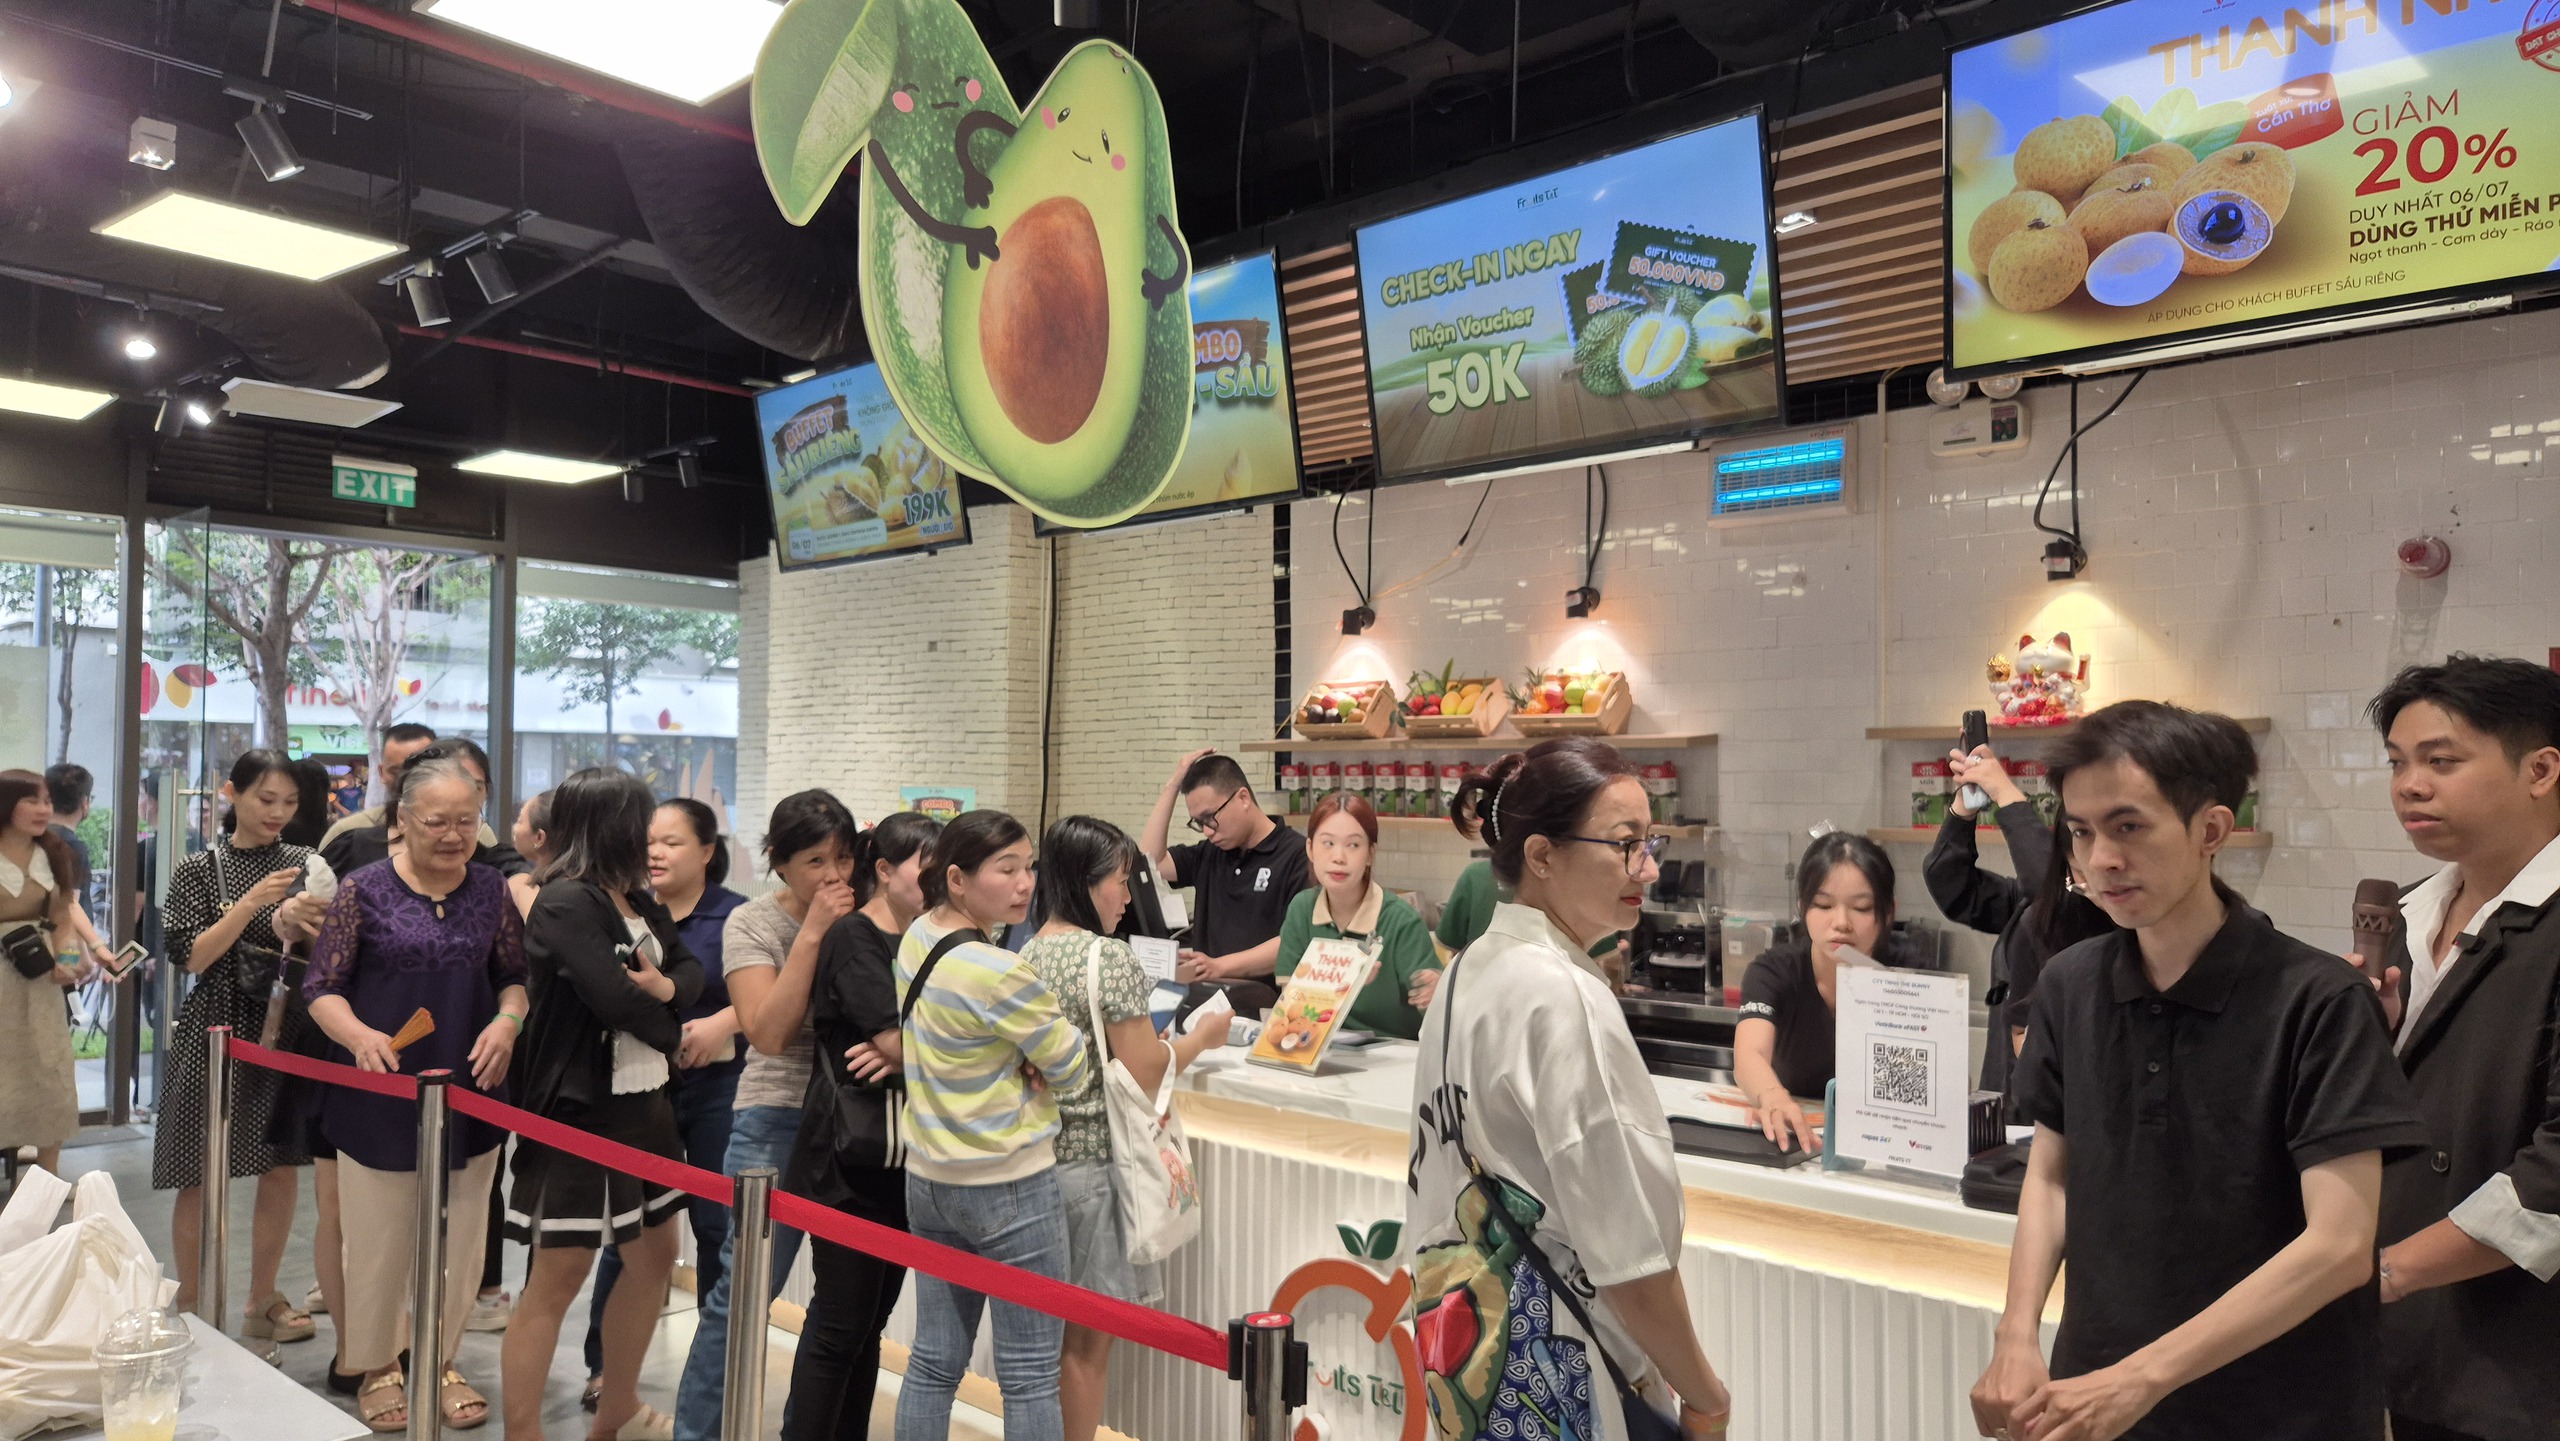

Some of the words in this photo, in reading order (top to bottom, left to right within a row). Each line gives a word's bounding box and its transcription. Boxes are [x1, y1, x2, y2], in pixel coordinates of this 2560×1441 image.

[2148, 0, 2378, 86] THANH
[2298, 98, 2332, 116] Thơ
[2353, 89, 2459, 136] GIẢM
[2353, 126, 2517, 197] 20%
[2350, 203, 2388, 224] DUY
[2394, 190, 2444, 216] NHẤT
[2450, 181, 2509, 205] 06/07
[2350, 220, 2418, 247] DÙNG
[2425, 206, 2473, 234] THỬ
[2480, 193, 2540, 224] MIỄN
[1644, 245, 1668, 259] GIFT
[1669, 249, 1717, 269] VOUCHER
[2349, 249, 2382, 264] Ngọt
[2387, 241, 2427, 257] thanh
[2443, 234, 2475, 247] Cơm
[2480, 228, 2508, 241] dày
[2524, 219, 2554, 232] Ráo
[1381, 250, 1500, 307] CHECK-IN
[1503, 228, 1582, 279] NGAY
[1628, 256, 1725, 291] 50.000VNĐ
[2147, 311, 2163, 323] ÁP
[2166, 306, 2202, 321] DỤNG
[2205, 299, 2235, 314] CHO
[2237, 291, 2282, 307] KHÁCH
[2285, 282, 2332, 300] BUFFET
[2365, 270, 2406, 286] RIÊNG
[1193, 329, 1242, 366] MBO
[1410, 322, 1457, 351] Nhận
[1457, 306, 1534, 341] Voucher
[1426, 341, 1531, 416] 50K
[784, 404, 834, 454] BUFFET
[337, 468, 410, 502] EXIT
[903, 488, 952, 526] 199K
[1318, 954, 1353, 967] THANH
